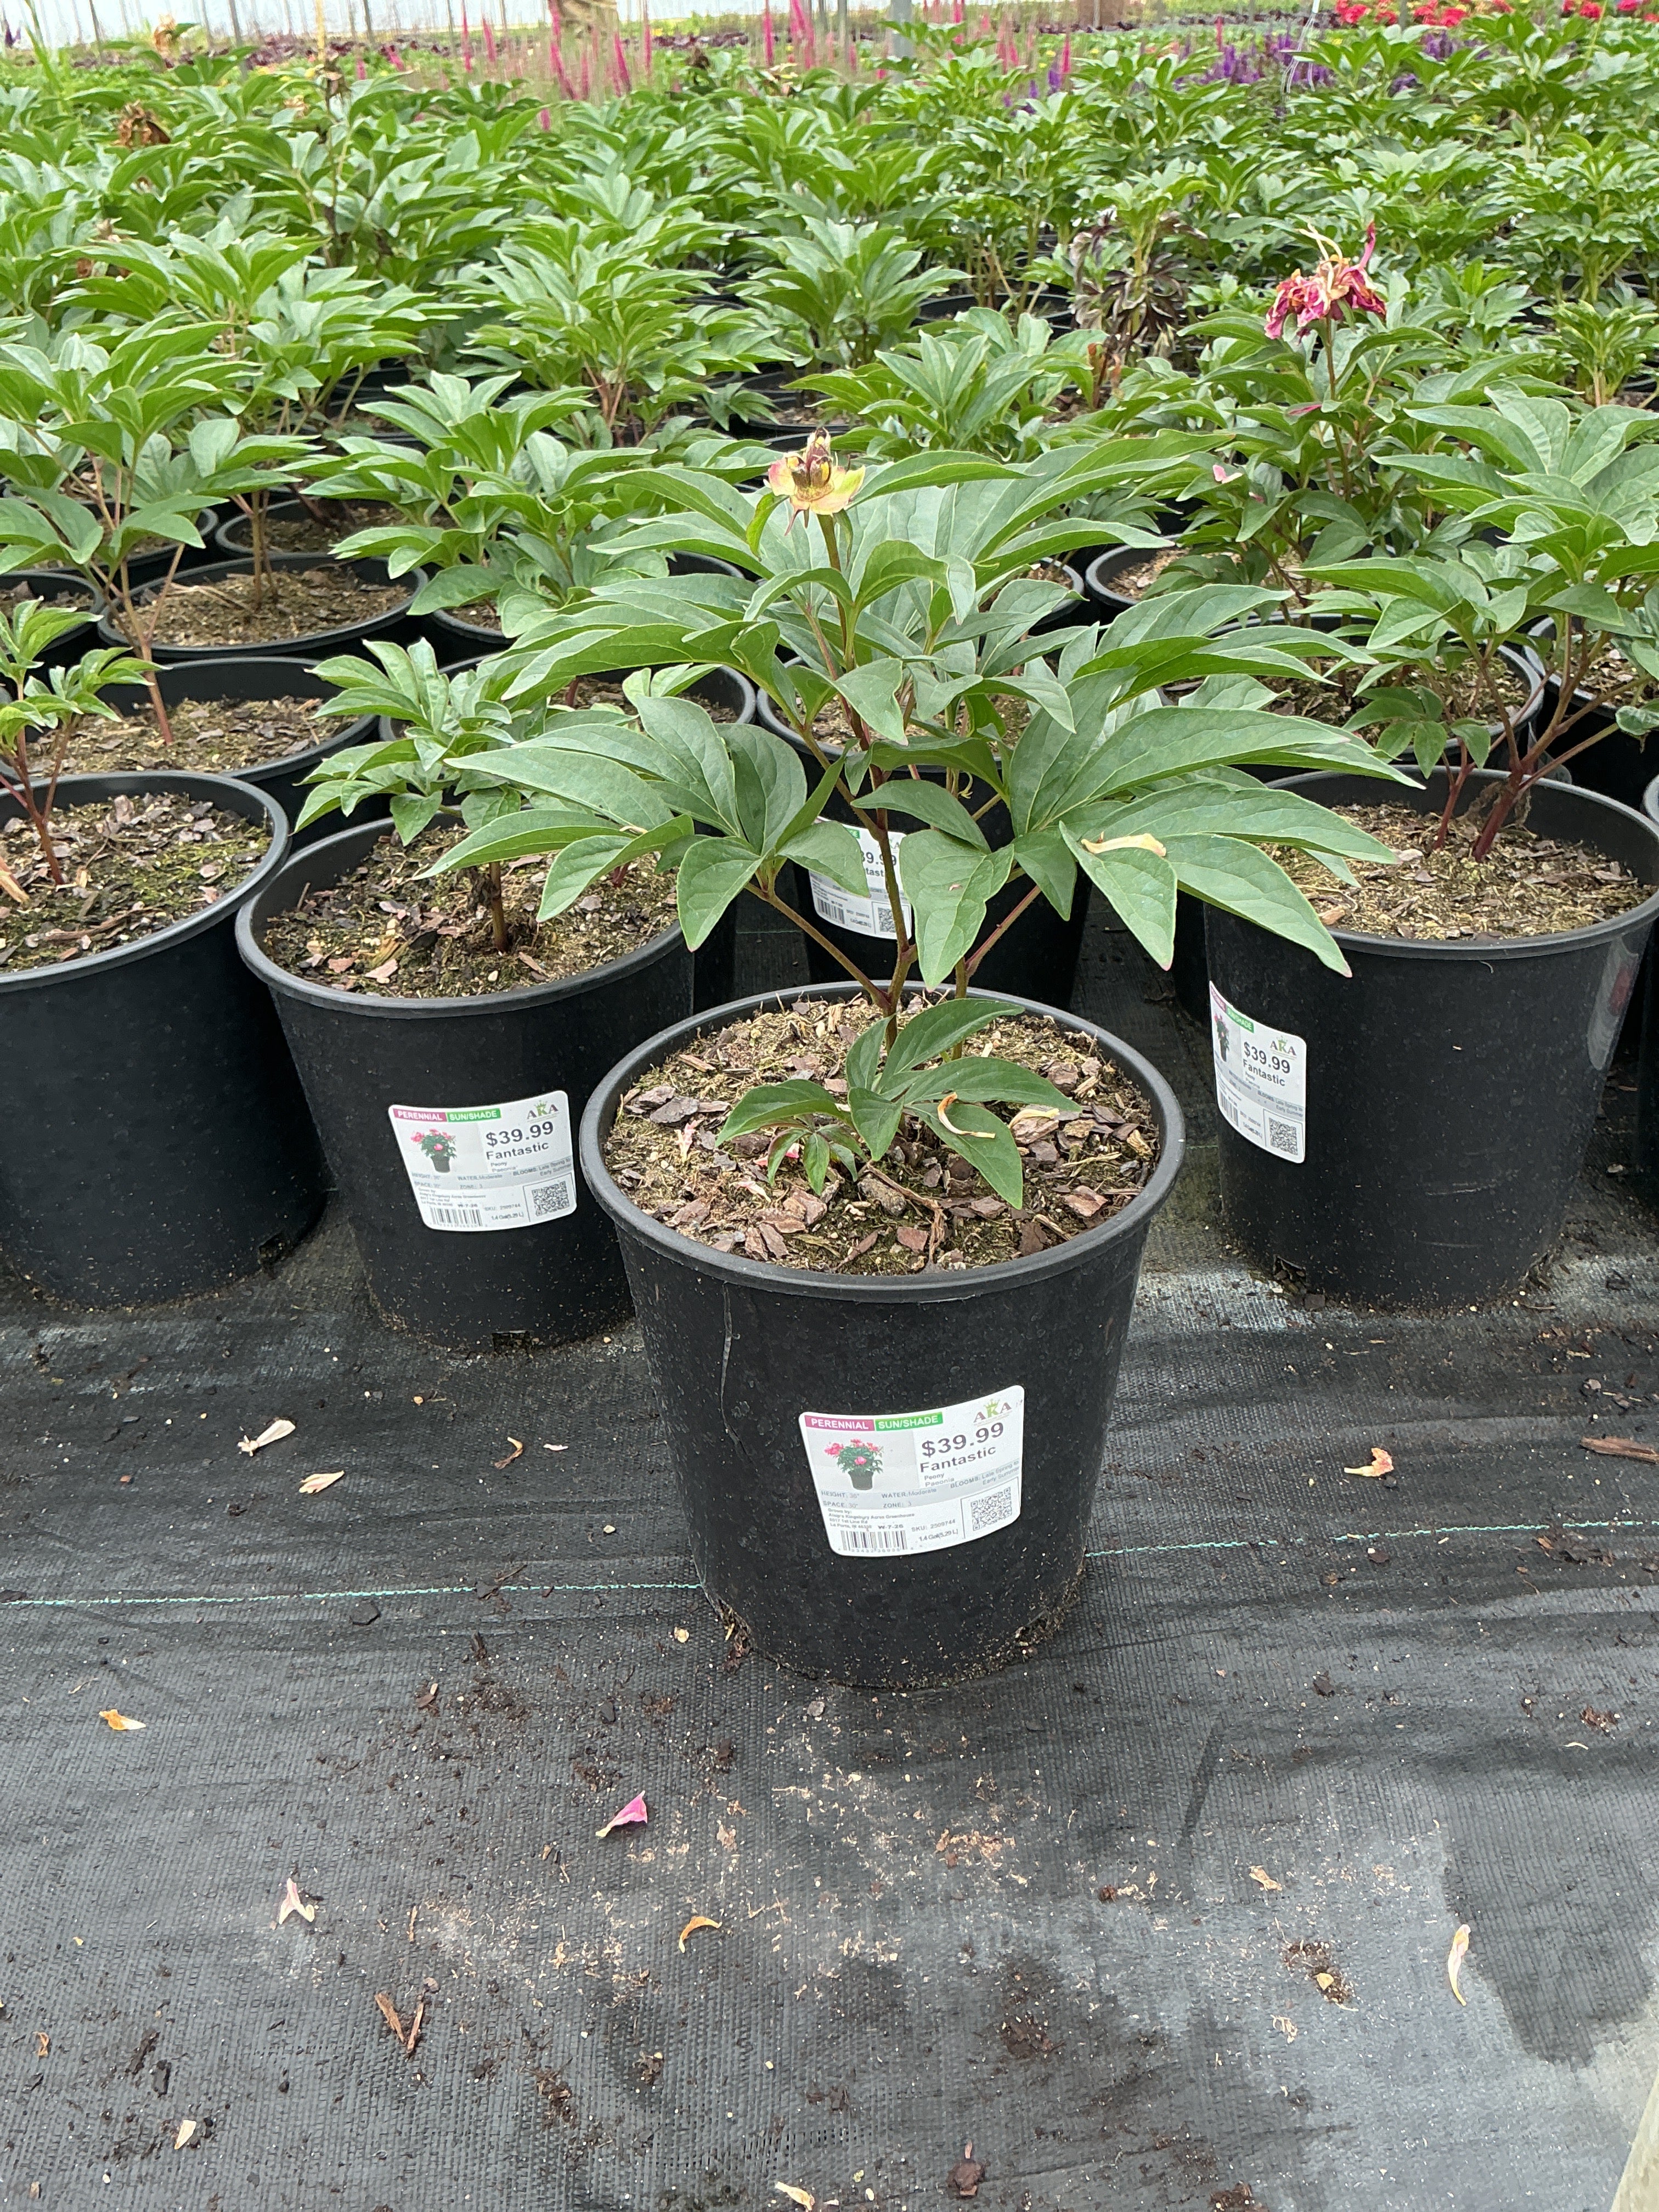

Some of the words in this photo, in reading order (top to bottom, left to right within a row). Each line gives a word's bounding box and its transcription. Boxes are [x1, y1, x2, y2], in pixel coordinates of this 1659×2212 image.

[1244, 1041, 1290, 1074] $39.99
[1270, 1040, 1297, 1056] AKA
[1243, 1059, 1285, 1087] Fantastic
[398, 1110, 443, 1121] PERENNIAL
[449, 1111, 497, 1121] SUN/SHADE
[527, 1104, 558, 1119] AKA
[486, 1121, 554, 1148] $39.99
[486, 1142, 549, 1160] Fantastic
[973, 1402, 1012, 1423] AKA
[811, 1418, 869, 1430] PERENNIAL
[878, 1415, 939, 1429] SUN/SHADE
[922, 1422, 1004, 1458] $39.99
[920, 1447, 996, 1472] Fantastic
[924, 1472, 945, 1481] Peony
[926, 1477, 954, 1487] Paeonia
[950, 1476, 981, 1488] BLOOMS:
[981, 1471, 994, 1479] Late
[995, 1464, 1013, 1474] Spring
[983, 1477, 996, 1486] Early
[998, 1466, 1020, 1480] Summer
[821, 1490, 848, 1498] HEIGHT:
